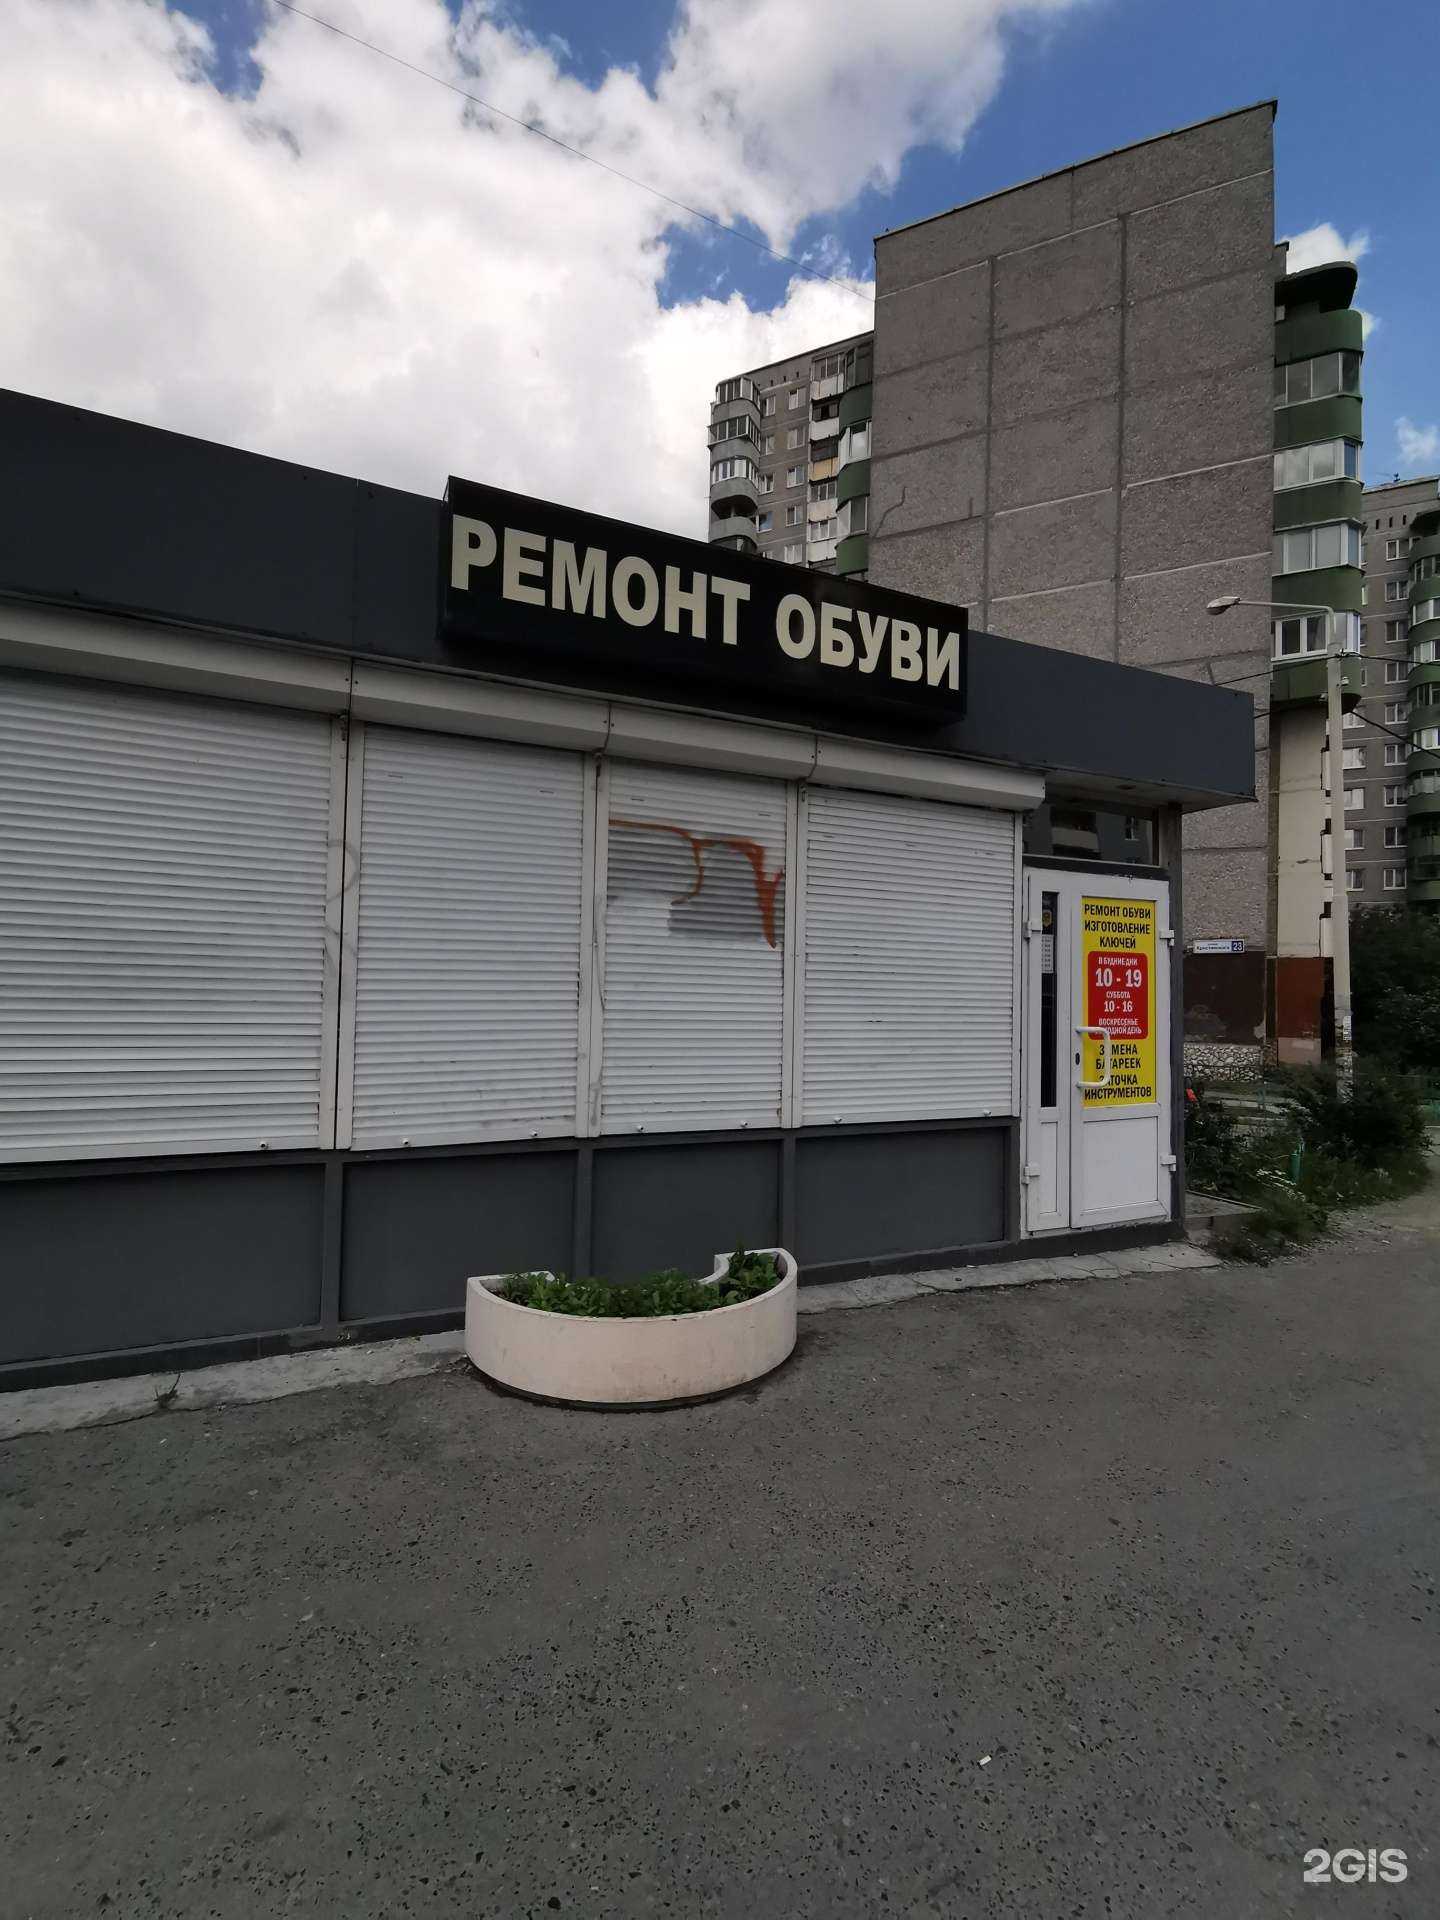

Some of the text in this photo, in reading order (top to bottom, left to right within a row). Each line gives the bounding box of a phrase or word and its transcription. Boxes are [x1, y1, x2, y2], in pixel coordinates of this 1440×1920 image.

[451, 514, 960, 691] РЕМОНТ ОБУВИ
[1084, 904, 1151, 919] РЕМОНТ ОБУВИ
[1084, 920, 1151, 934] ИЗГОТОВЛЕНИЕ
[1100, 936, 1136, 948] КЛЮЧЕЙ
[1095, 967, 1113, 987] 10
[1125, 968, 1142, 988] 19
[1106, 990, 1131, 999] СУББОТА
[1104, 1000, 1115, 1012] 10
[1122, 1001, 1133, 1012] 16
[1099, 1044, 1138, 1055] ЗМЕНА
[1084, 1086, 1152, 1100] ИНСТРУМЕНТОВ
